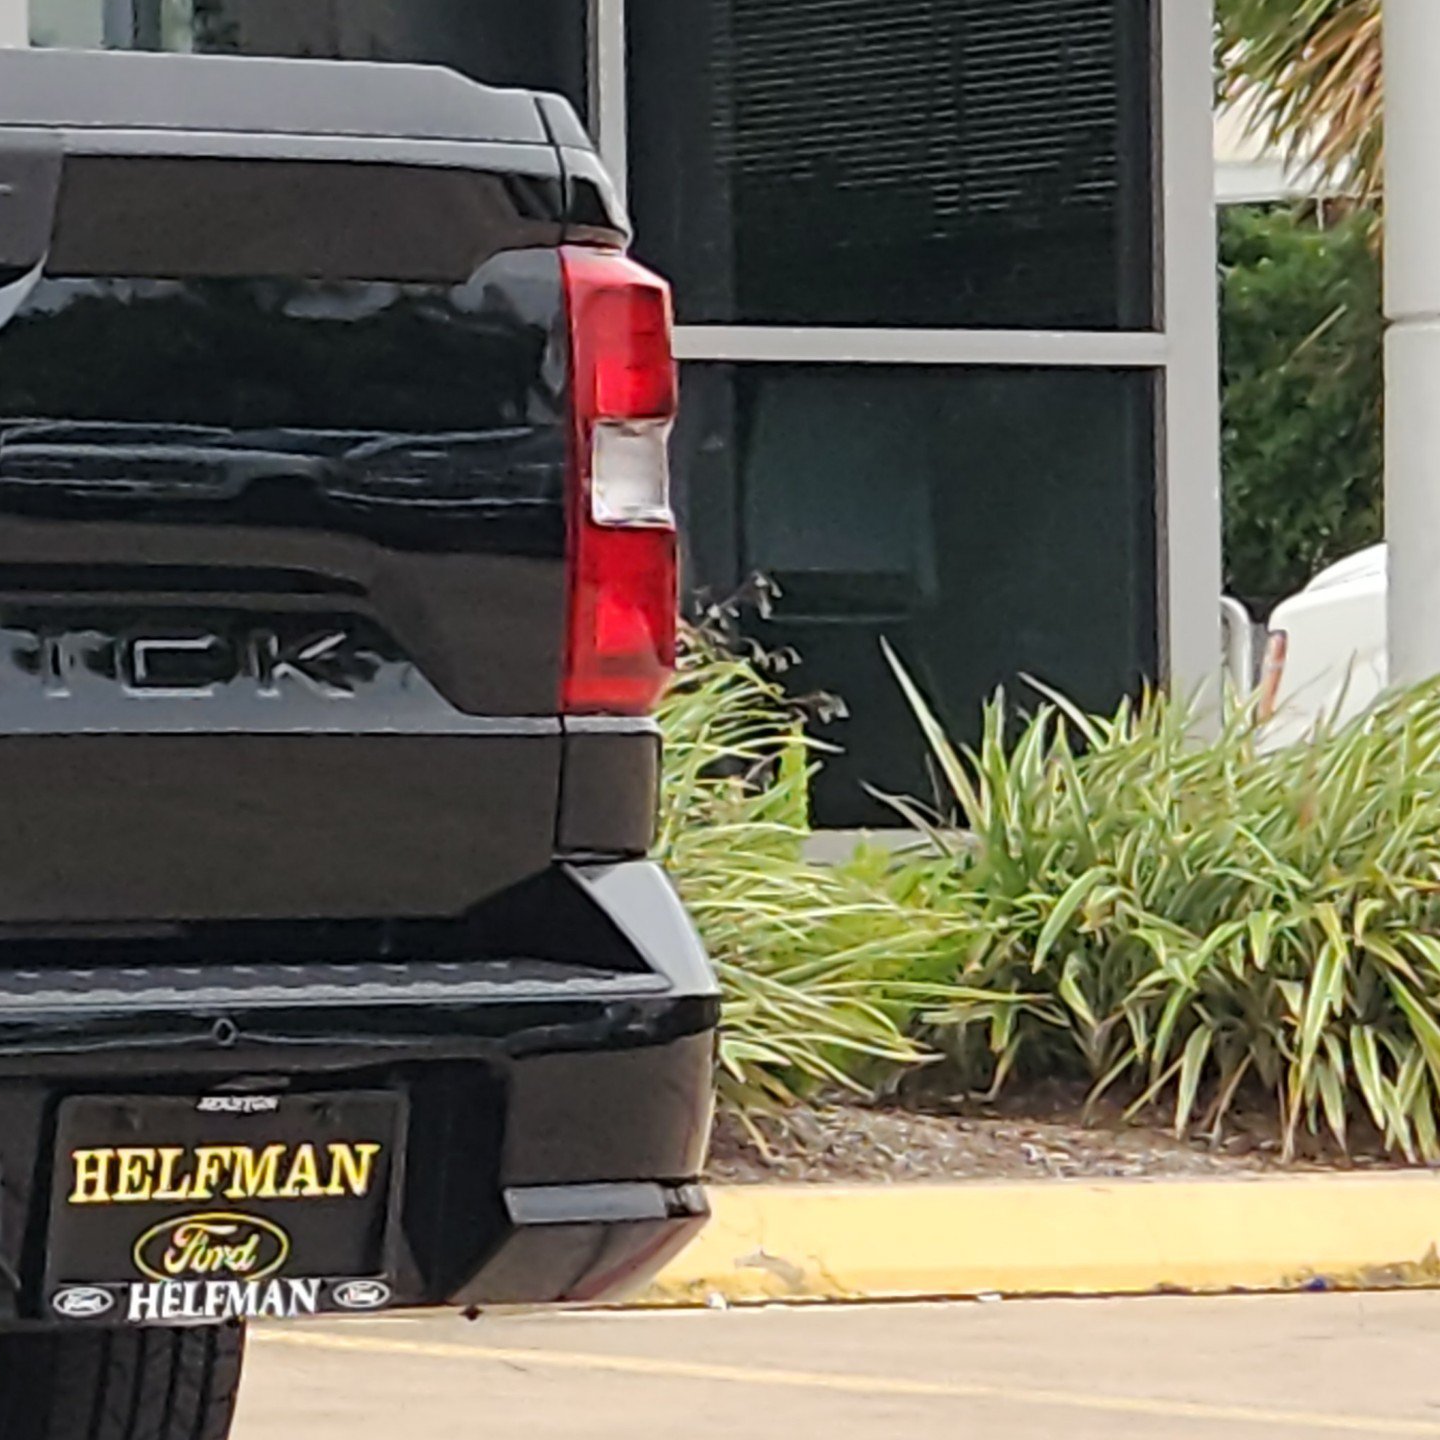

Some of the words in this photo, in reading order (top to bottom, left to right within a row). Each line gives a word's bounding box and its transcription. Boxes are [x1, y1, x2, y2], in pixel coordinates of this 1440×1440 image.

[69, 1143, 381, 1203] HELFMAN
[164, 1222, 261, 1274] Ford
[127, 1278, 322, 1321] HELFMAN
